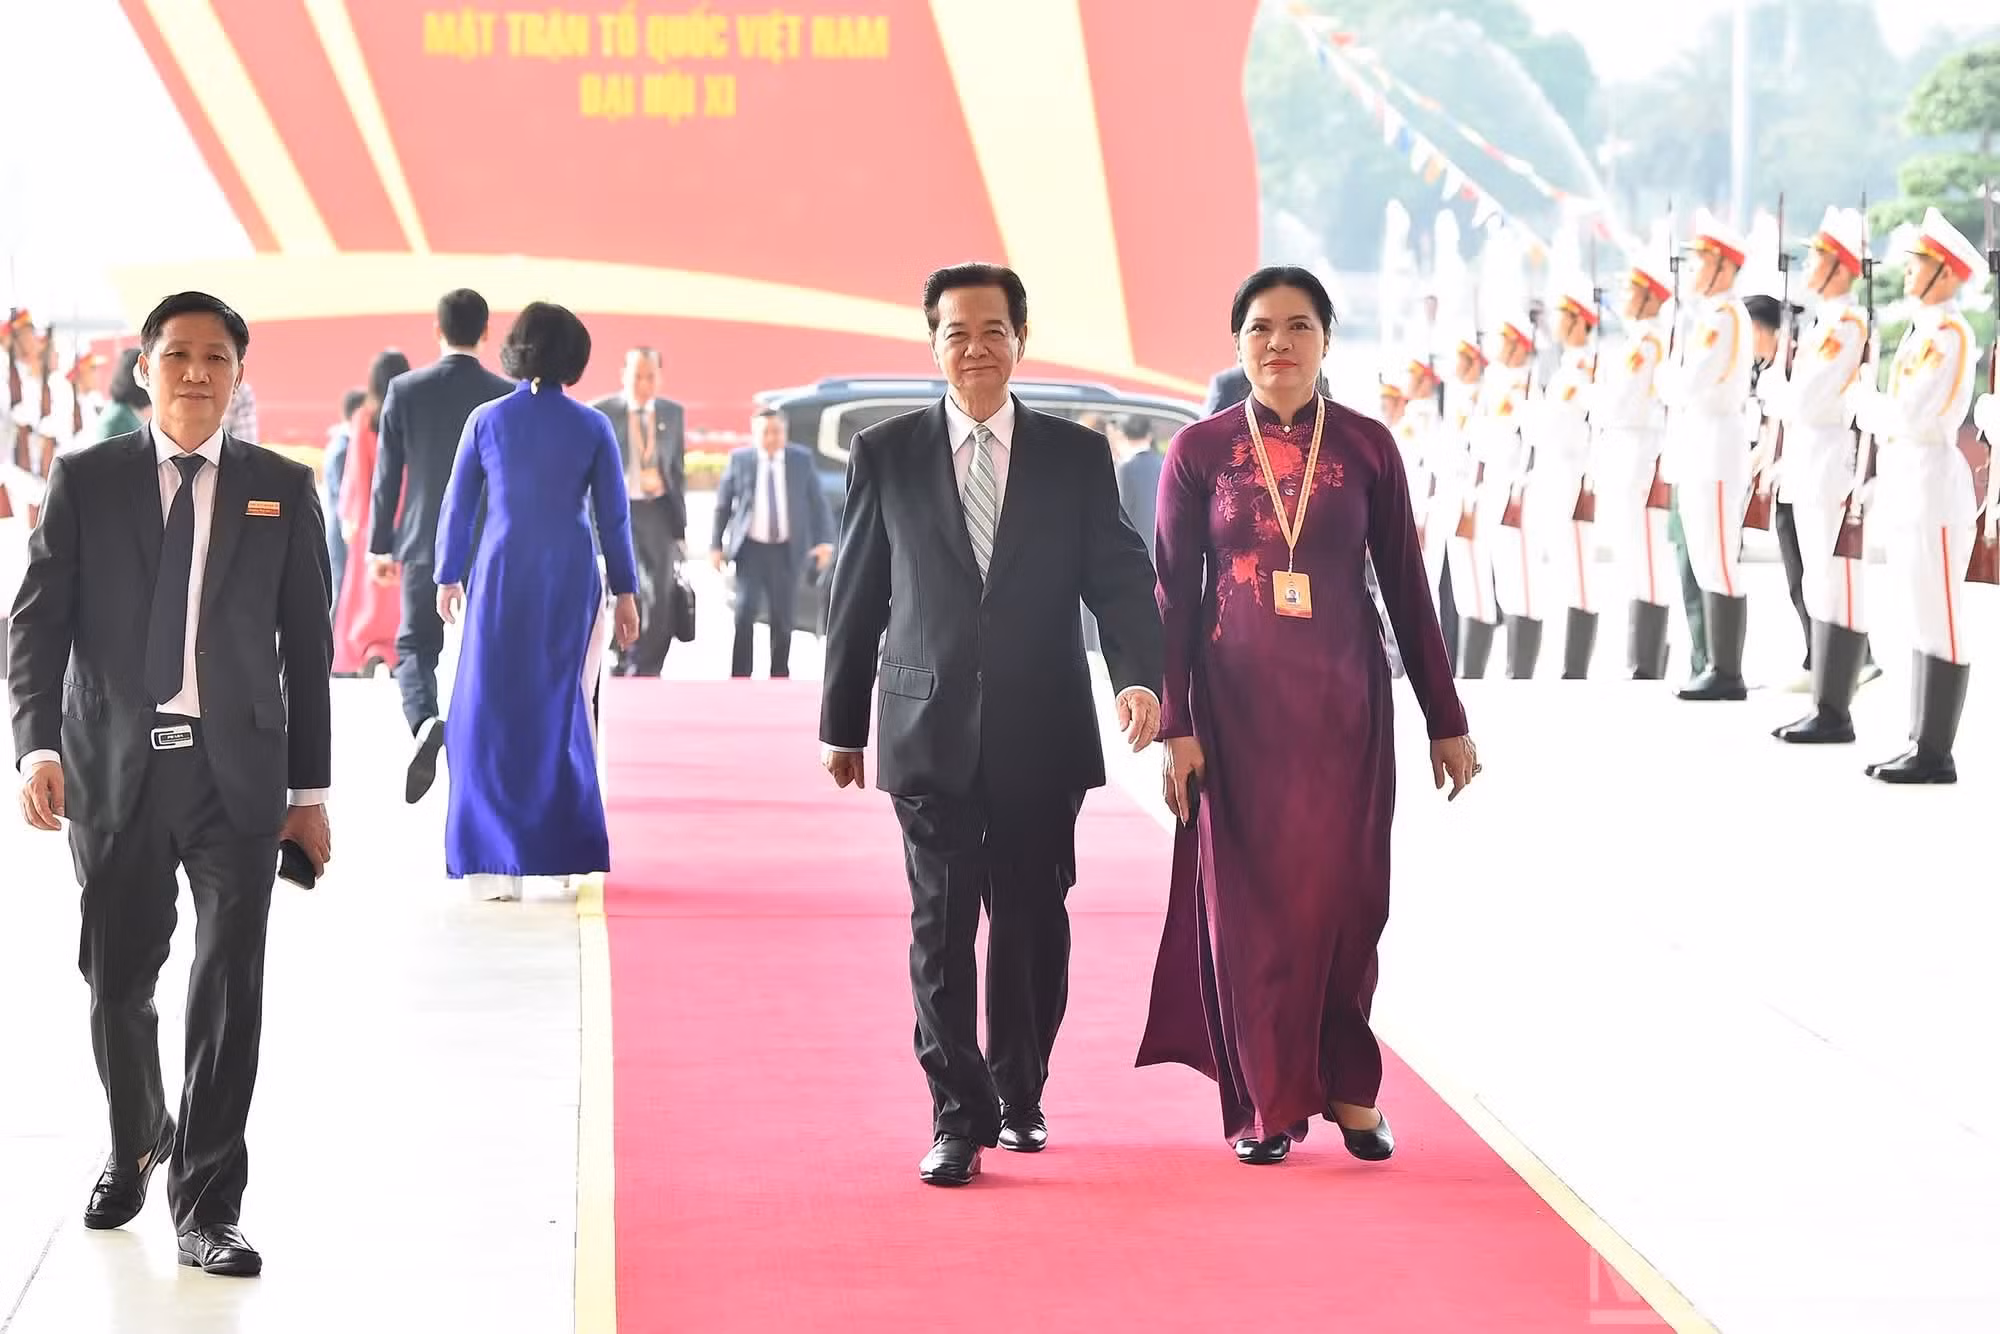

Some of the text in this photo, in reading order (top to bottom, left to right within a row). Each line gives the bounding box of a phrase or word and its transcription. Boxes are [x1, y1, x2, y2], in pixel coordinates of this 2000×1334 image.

[736, 9, 803, 64] VIỆT
[812, 15, 889, 58] NAM
[704, 74, 737, 117] XI
